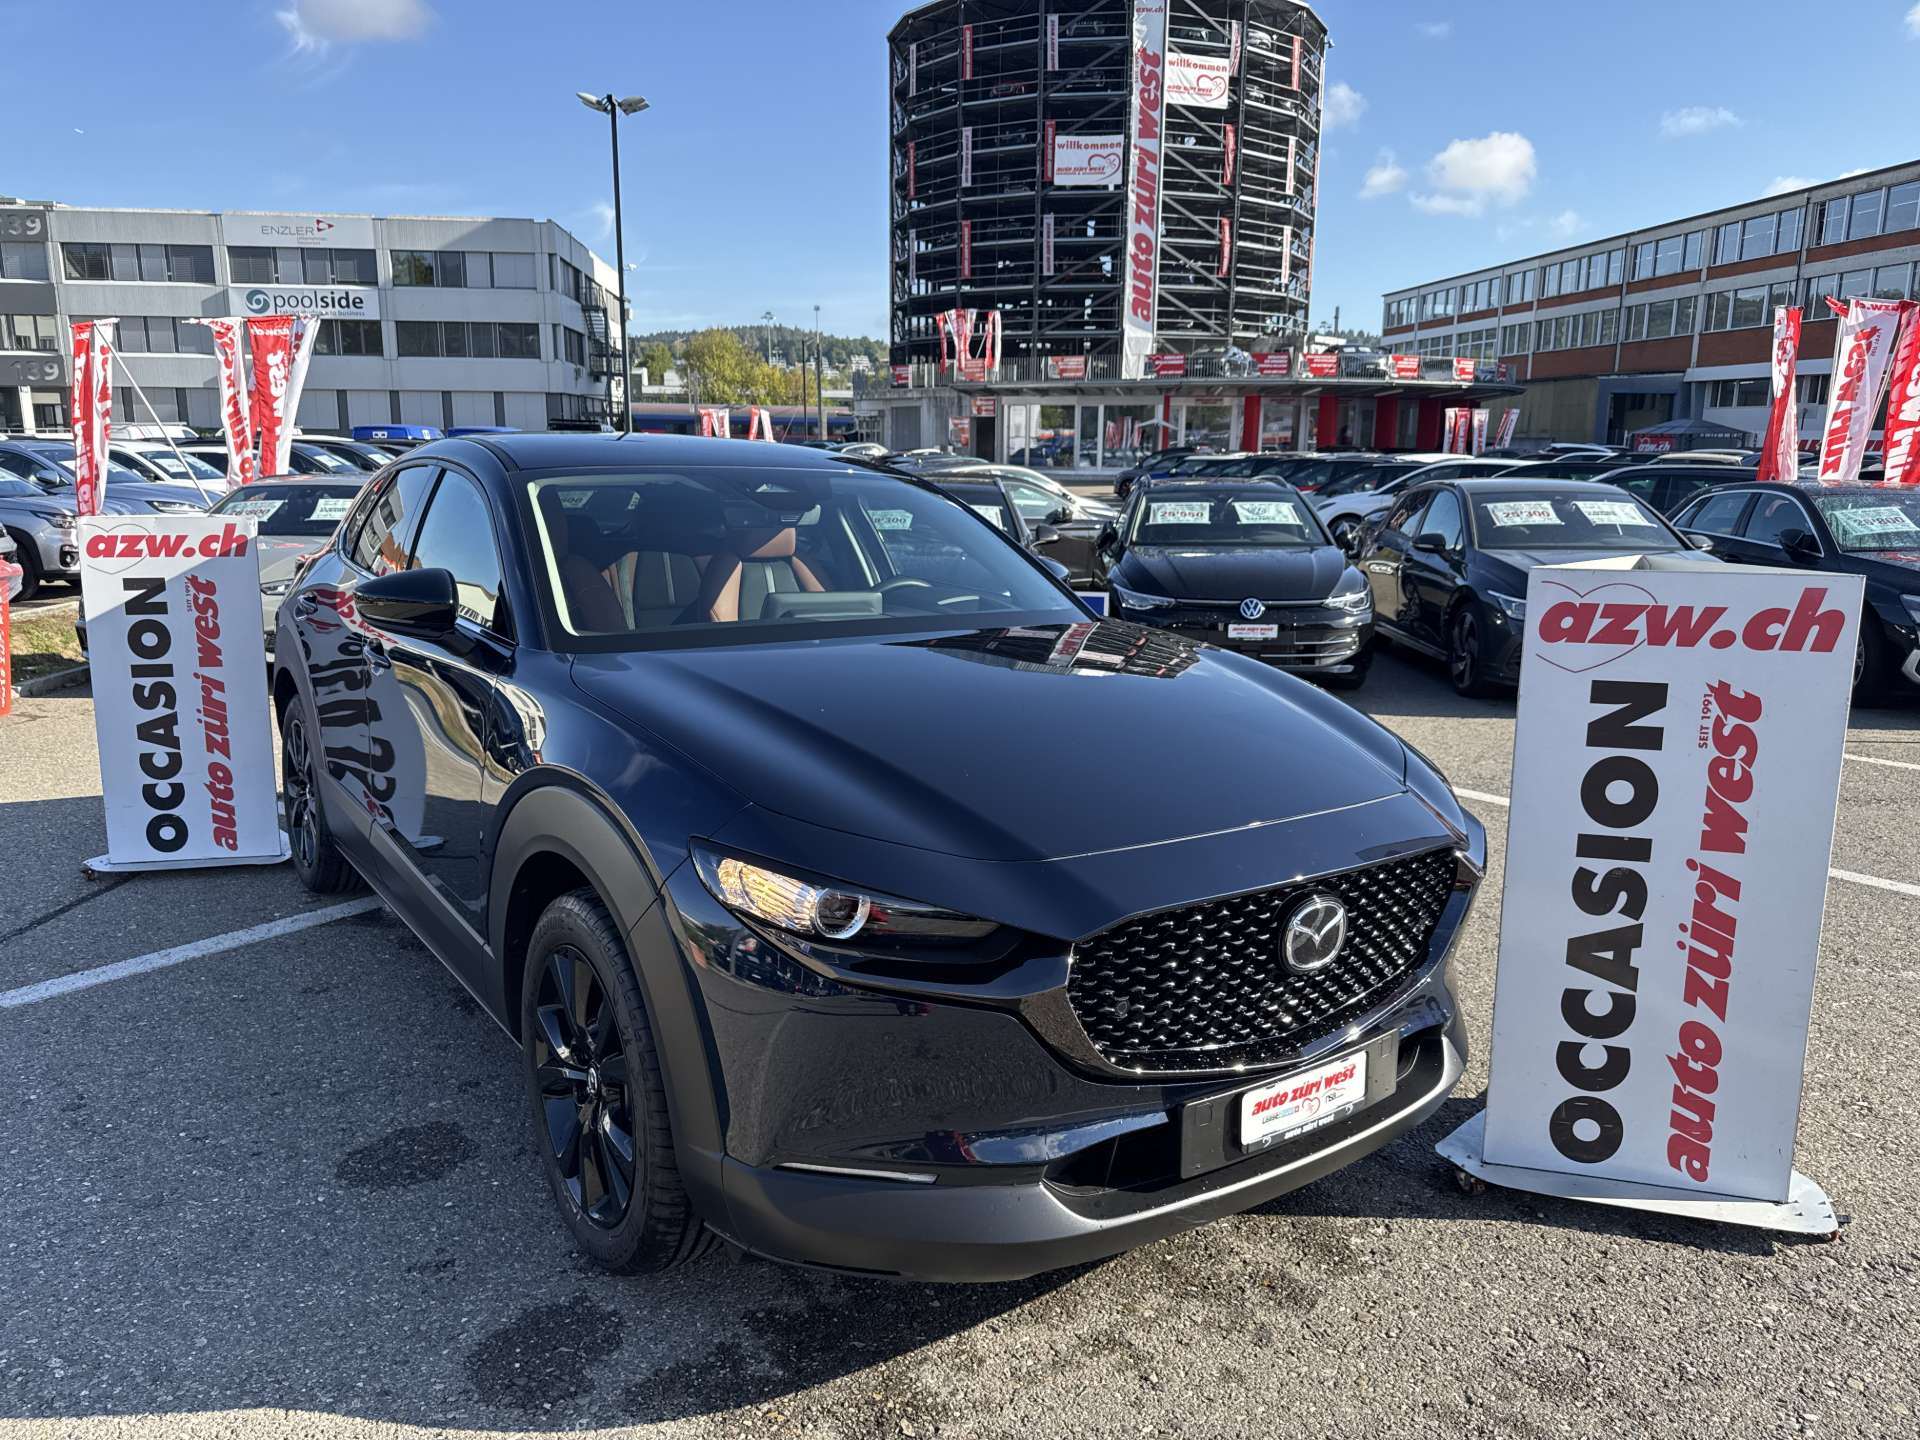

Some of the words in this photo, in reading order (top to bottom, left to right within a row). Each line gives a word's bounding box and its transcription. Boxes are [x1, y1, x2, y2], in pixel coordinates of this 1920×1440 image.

[1137, 47, 1162, 139] west
[1167, 57, 1228, 72] willkommen
[1056, 140, 1122, 150] willkommen
[0, 214, 42, 236] 39
[1130, 143, 1158, 232] züri
[260, 224, 315, 236] ENZLER
[273, 290, 365, 315] poolside
[1129, 232, 1154, 322] auto
[9, 360, 60, 382] 139
[86, 523, 249, 559] azw.ch
[190, 573, 225, 668] west
[1538, 587, 1847, 654] azw.ch
[122, 577, 190, 853] OCCASION
[192, 671, 232, 761] züri
[1698, 724, 1710, 749] SEIT
[1700, 693, 1713, 721] 1991
[1699, 679, 1763, 854] west
[203, 761, 239, 852] auto
[1549, 679, 1669, 1163] OCCASION
[1676, 857, 1742, 1024] züri
[1251, 1091, 1288, 1116] auto
[1288, 1075, 1322, 1105] züri
[1323, 1063, 1357, 1089] west
[1665, 1019, 1723, 1183] auto
